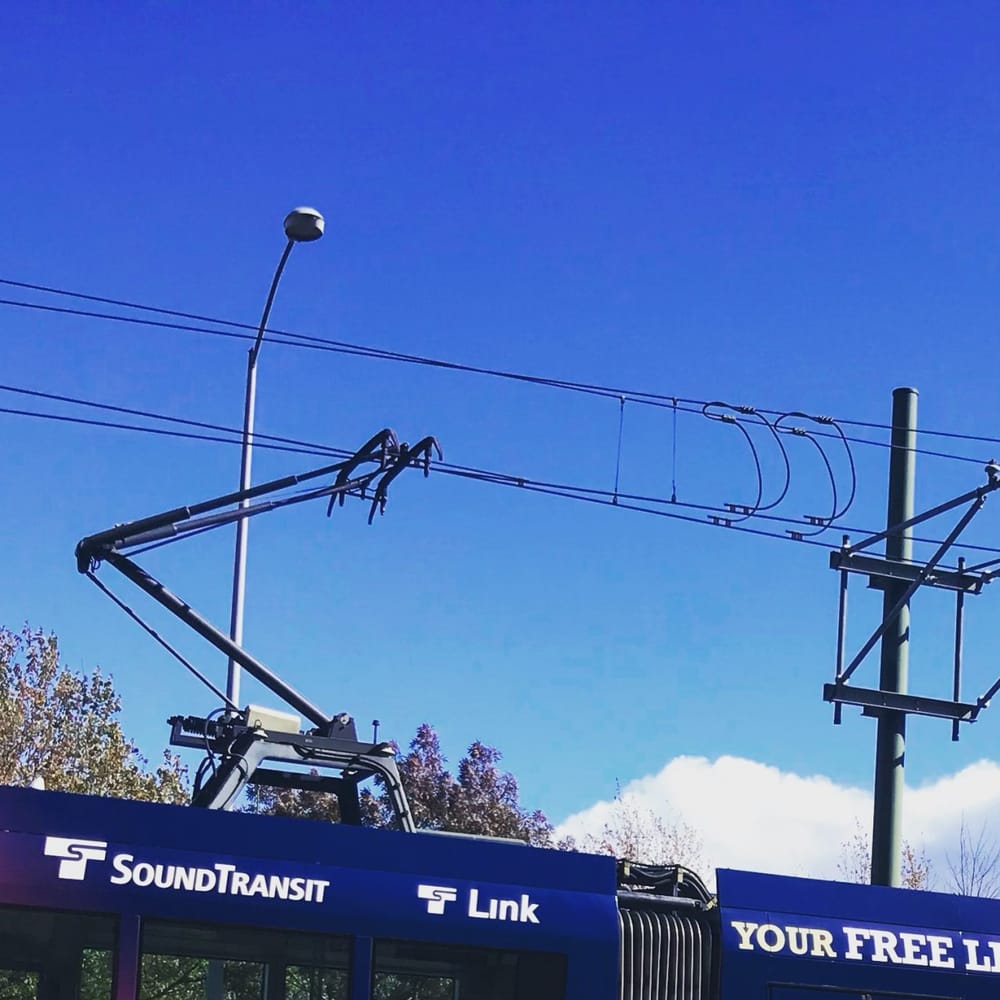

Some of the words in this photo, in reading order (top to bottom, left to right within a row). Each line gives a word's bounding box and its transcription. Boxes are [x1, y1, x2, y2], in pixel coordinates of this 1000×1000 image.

[468, 888, 540, 924] Link
[731, 921, 838, 958] YOUR
[842, 927, 955, 969] FREE
